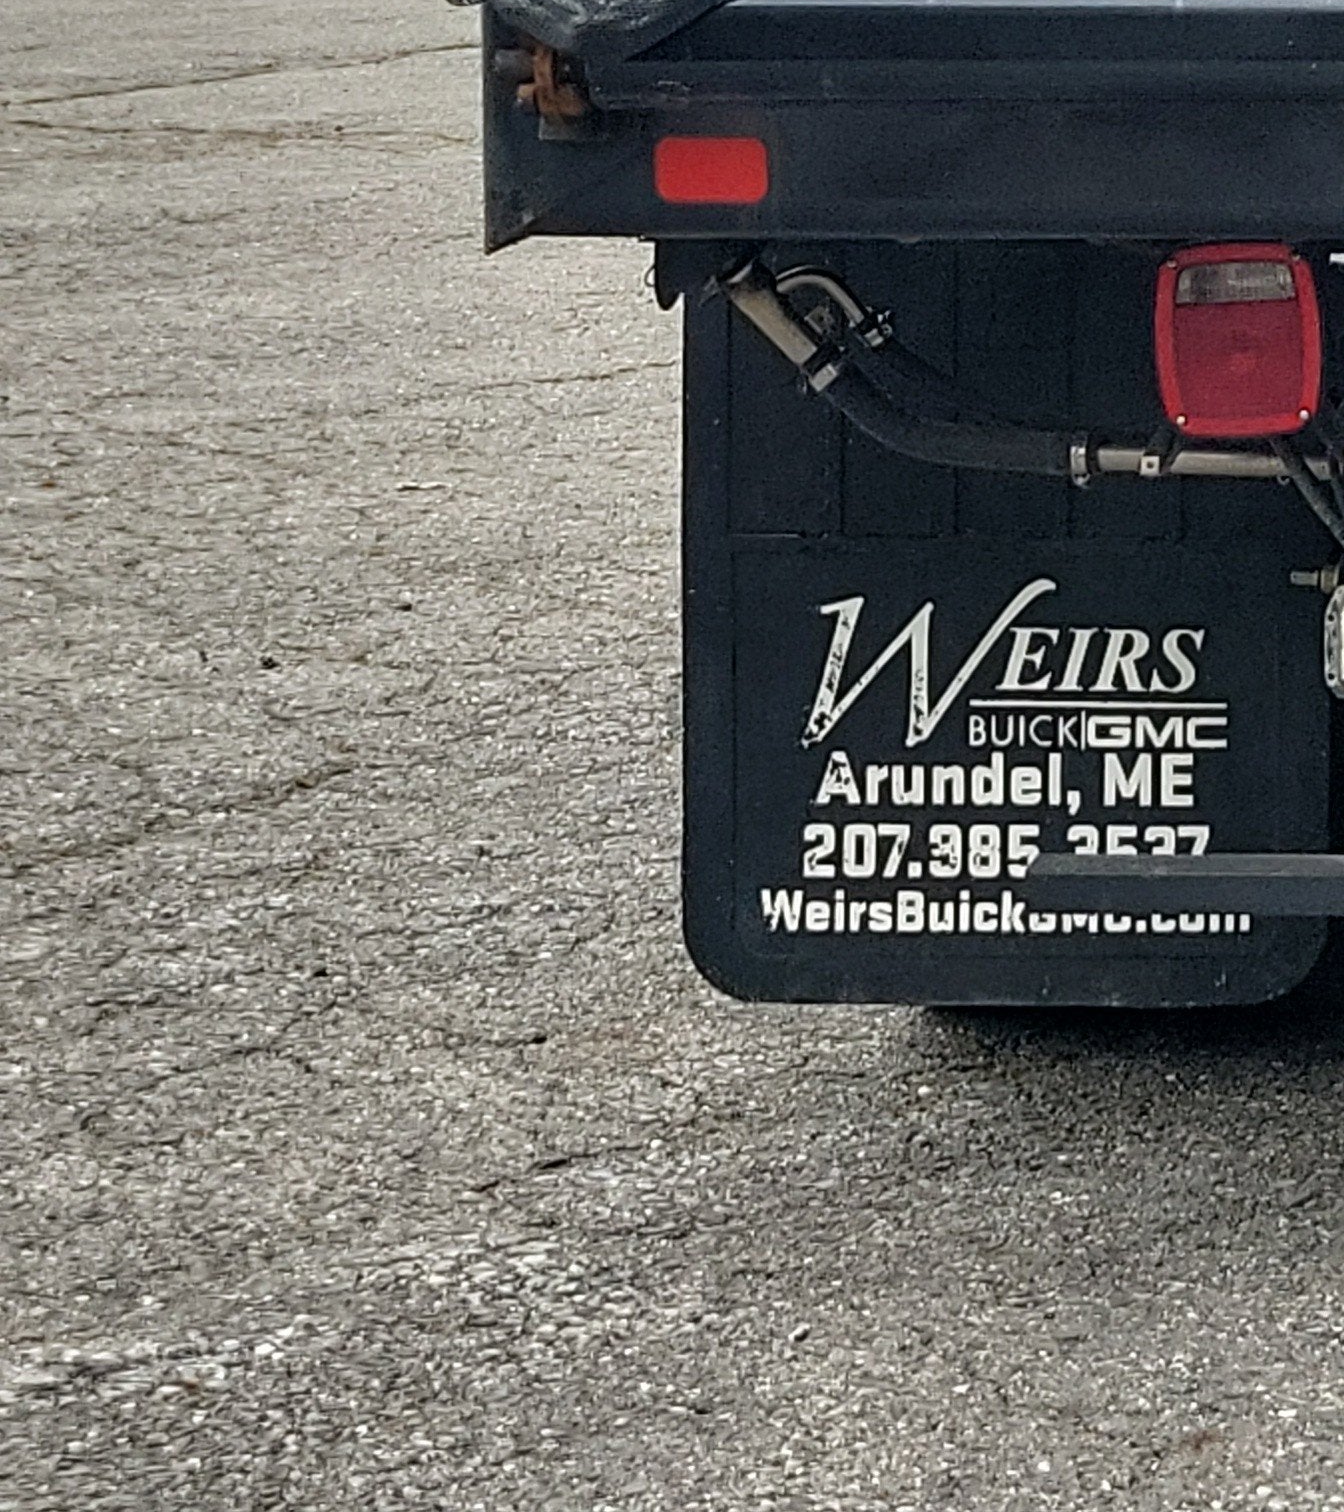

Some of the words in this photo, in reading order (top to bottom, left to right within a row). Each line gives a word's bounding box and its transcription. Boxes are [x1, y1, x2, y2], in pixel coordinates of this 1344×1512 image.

[801, 579, 1205, 748] WEIRS
[814, 750, 1081, 816] Arundel,
[1103, 752, 1194, 807] ME
